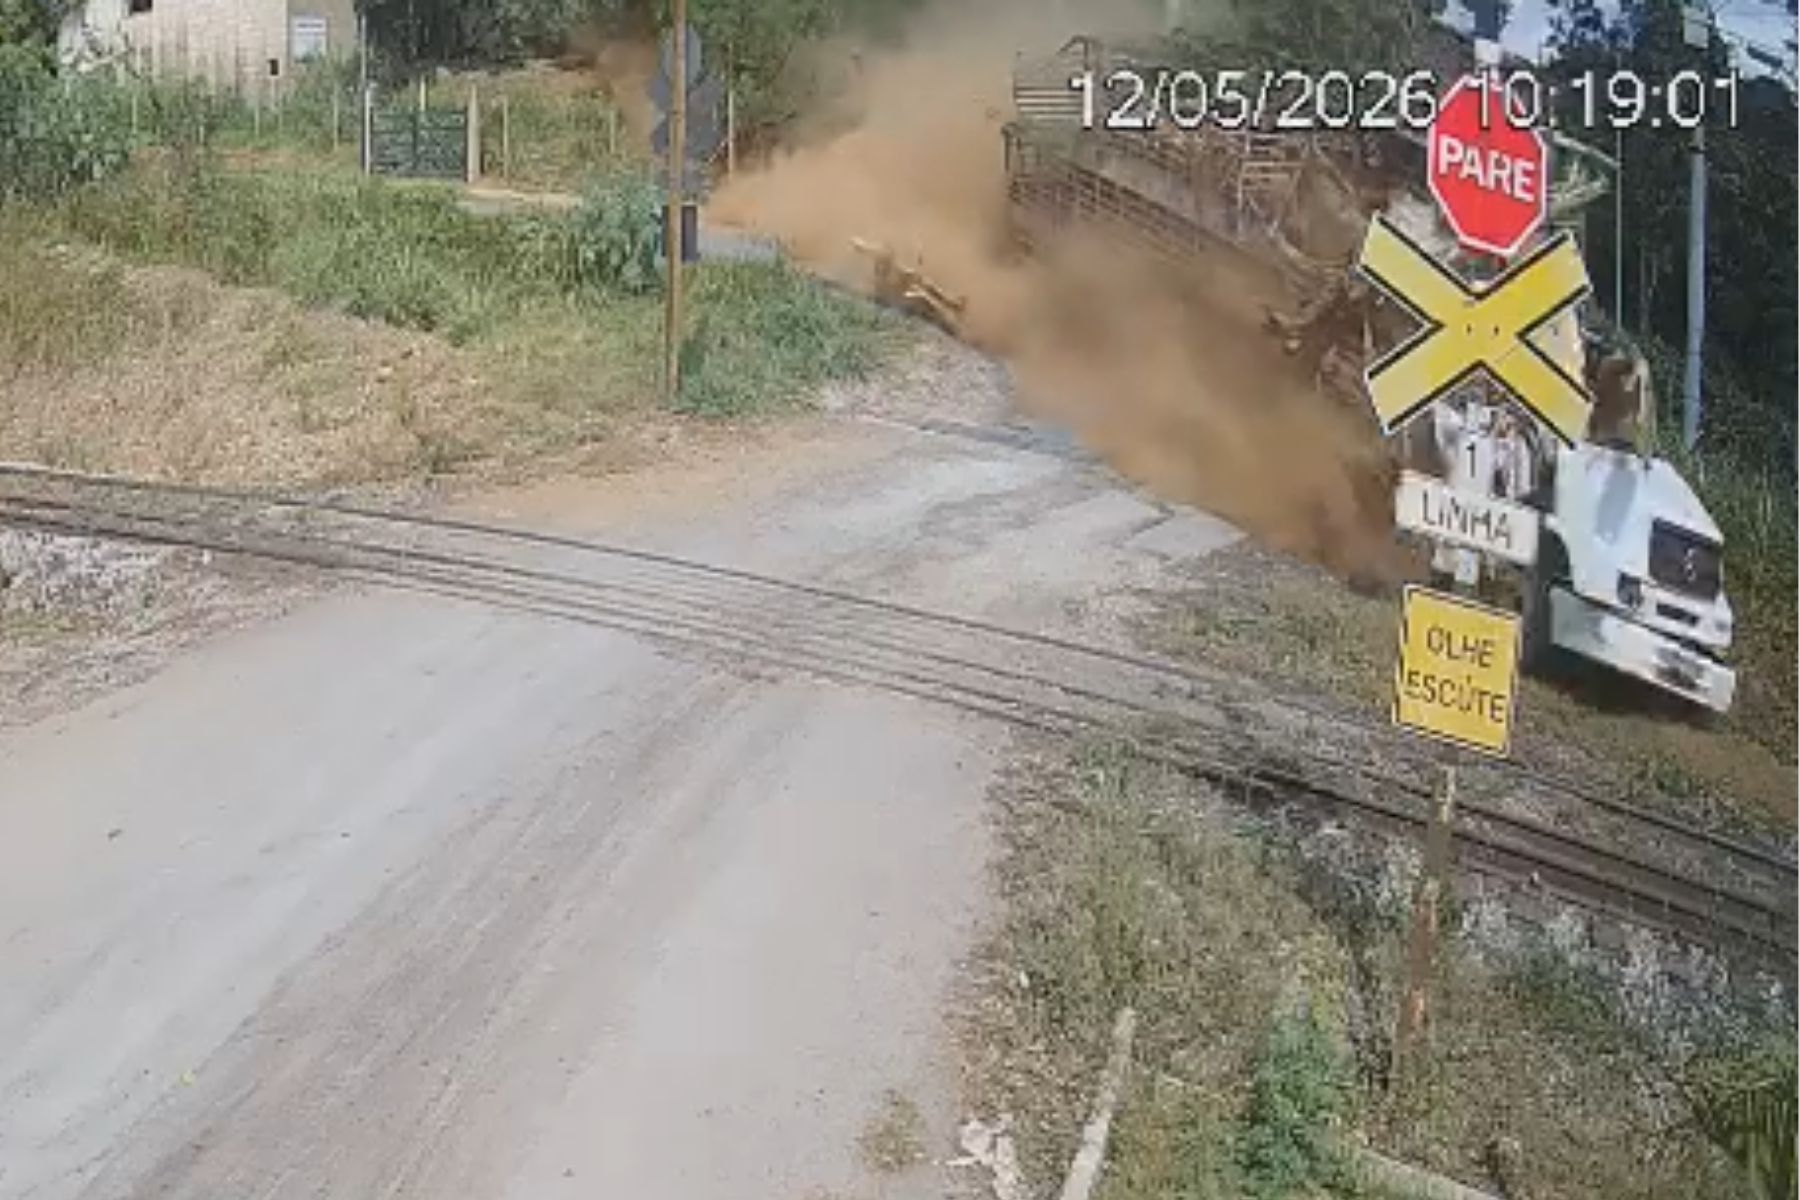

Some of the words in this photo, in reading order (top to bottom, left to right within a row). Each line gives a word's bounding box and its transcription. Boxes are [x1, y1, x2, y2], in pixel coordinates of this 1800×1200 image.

[1438, 135, 1535, 202] PARE
[1423, 490, 1510, 549] LINHA
[1427, 626, 1495, 668] OLHE
